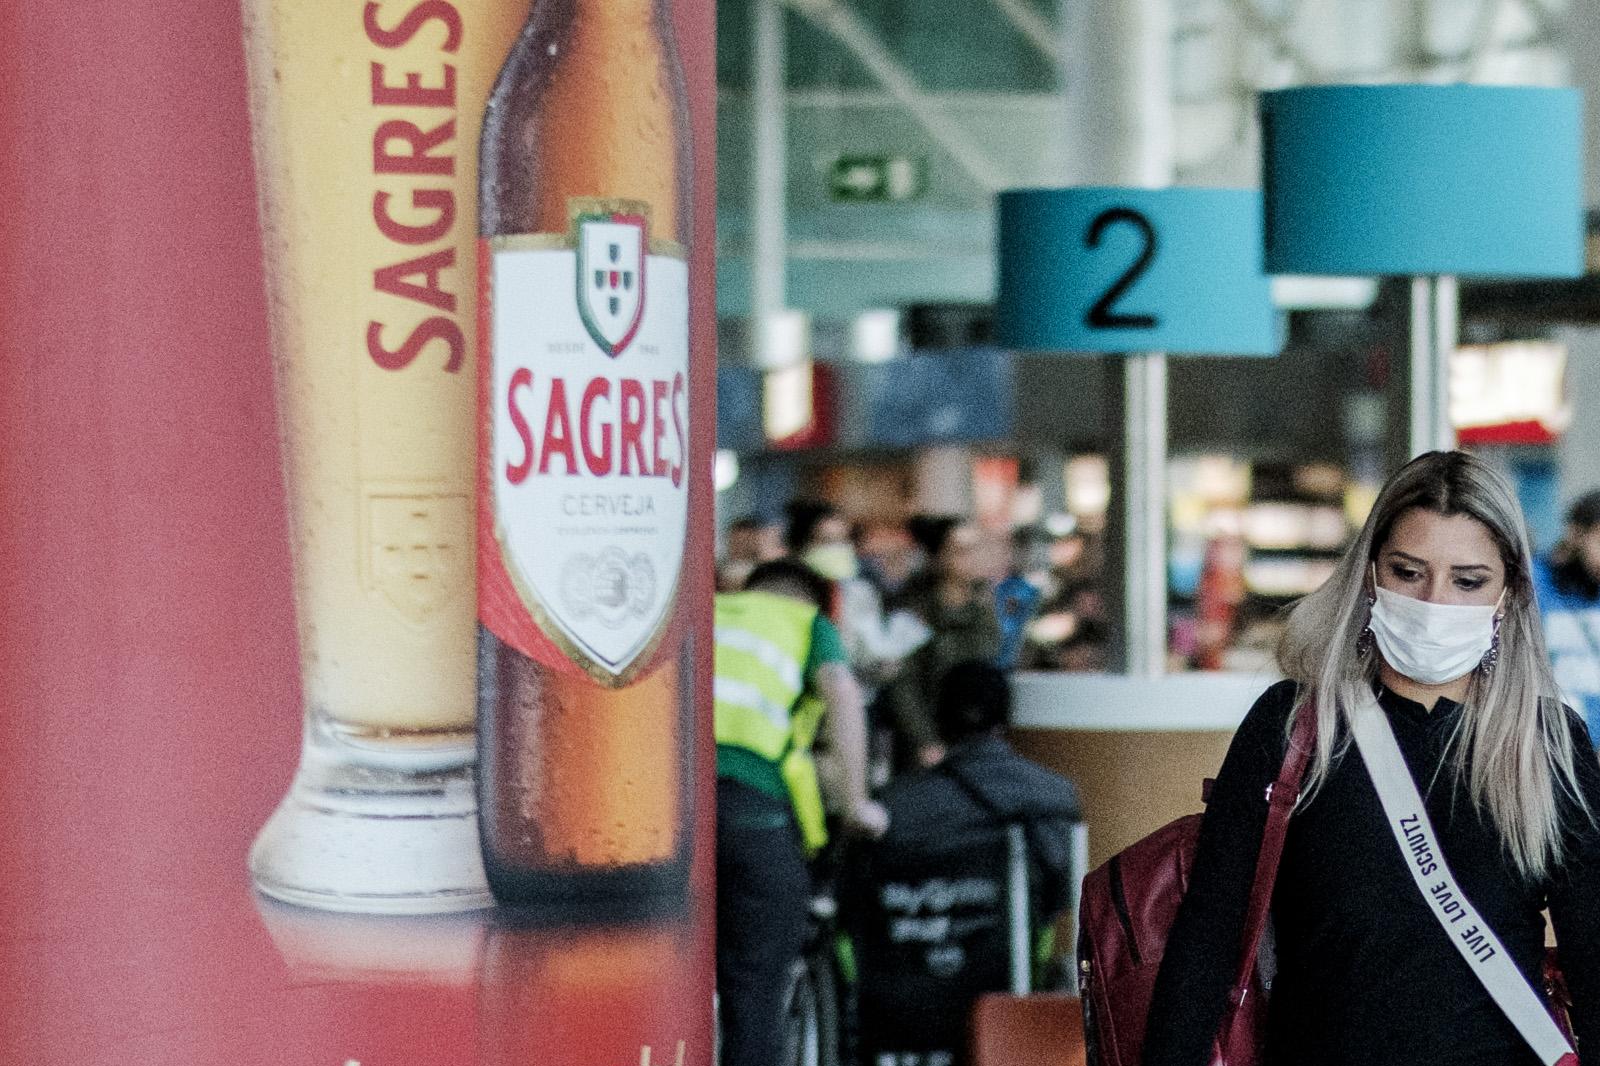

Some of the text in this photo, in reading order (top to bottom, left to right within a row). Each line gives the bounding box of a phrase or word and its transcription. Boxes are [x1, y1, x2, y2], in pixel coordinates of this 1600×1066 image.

[362, 0, 467, 375] SAGRES
[1084, 207, 1159, 327] 2
[505, 366, 686, 490] SAGRES
[562, 493, 657, 517] CERVEJA
[1399, 812, 1497, 963] LIVE LOVE SCHUTZ
